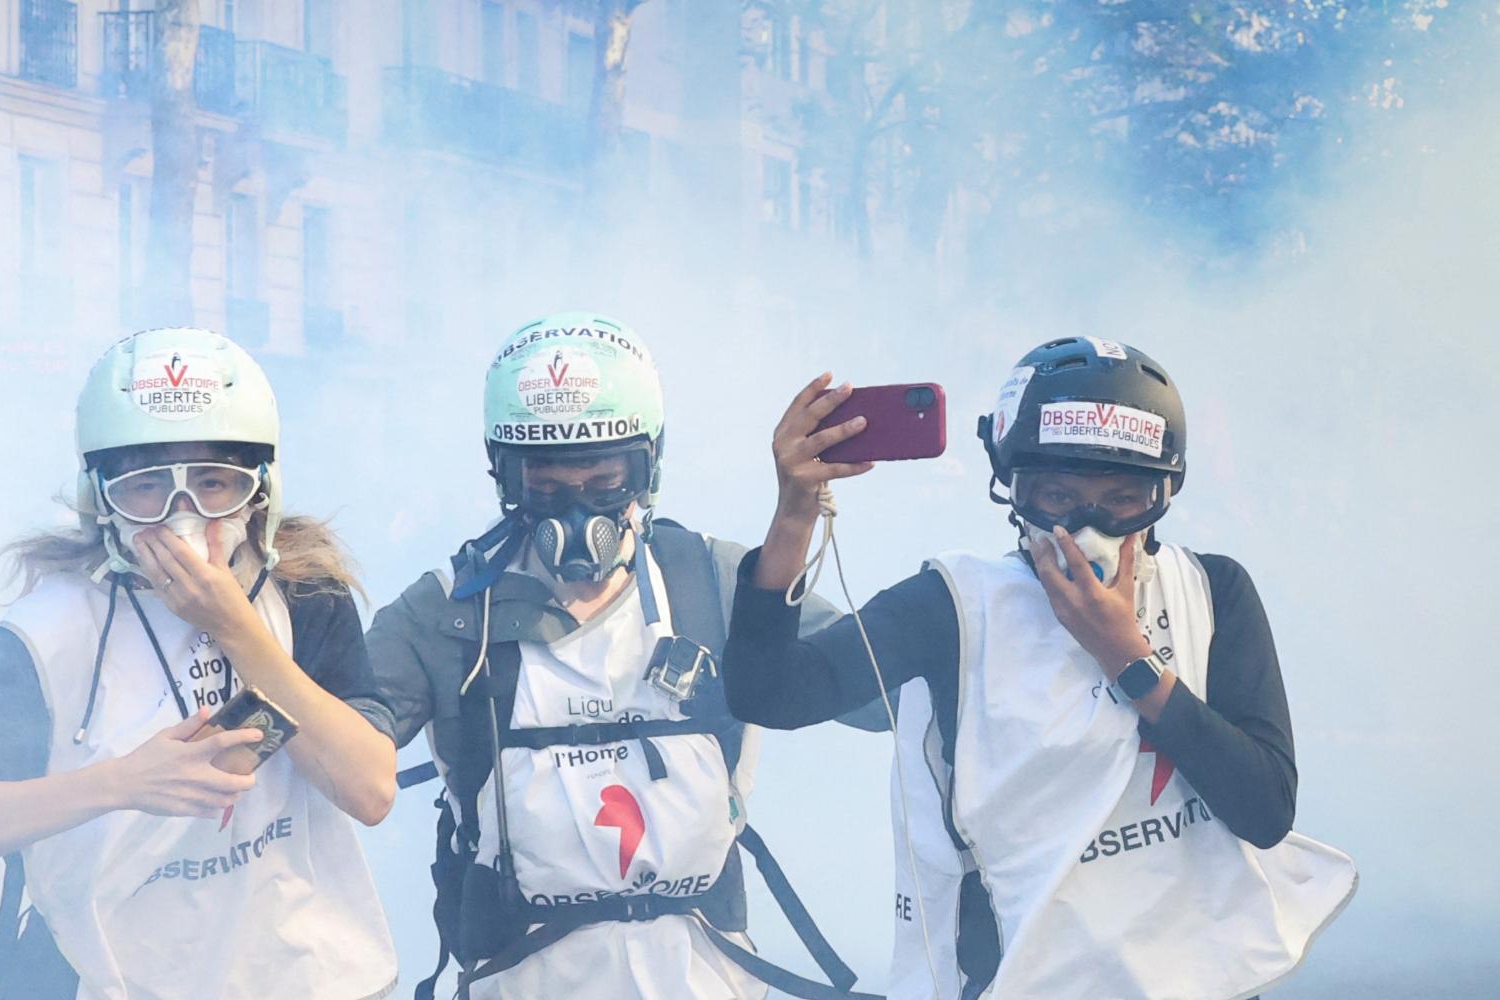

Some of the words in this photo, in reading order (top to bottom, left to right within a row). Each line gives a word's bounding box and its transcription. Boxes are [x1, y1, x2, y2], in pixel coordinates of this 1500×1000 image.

[131, 364, 220, 392] OBSERVATOIRE
[518, 363, 599, 392] OBSERVATOIRE
[148, 404, 204, 414] PUBLIQUES
[533, 404, 583, 415] PUBLIQUES
[493, 417, 640, 442] OBSERVATION
[1042, 403, 1163, 440] OBSERVATOIRE
[1112, 429, 1160, 450] PUBLIQUES
[188, 658, 224, 680] dro
[567, 696, 614, 718] Ligu
